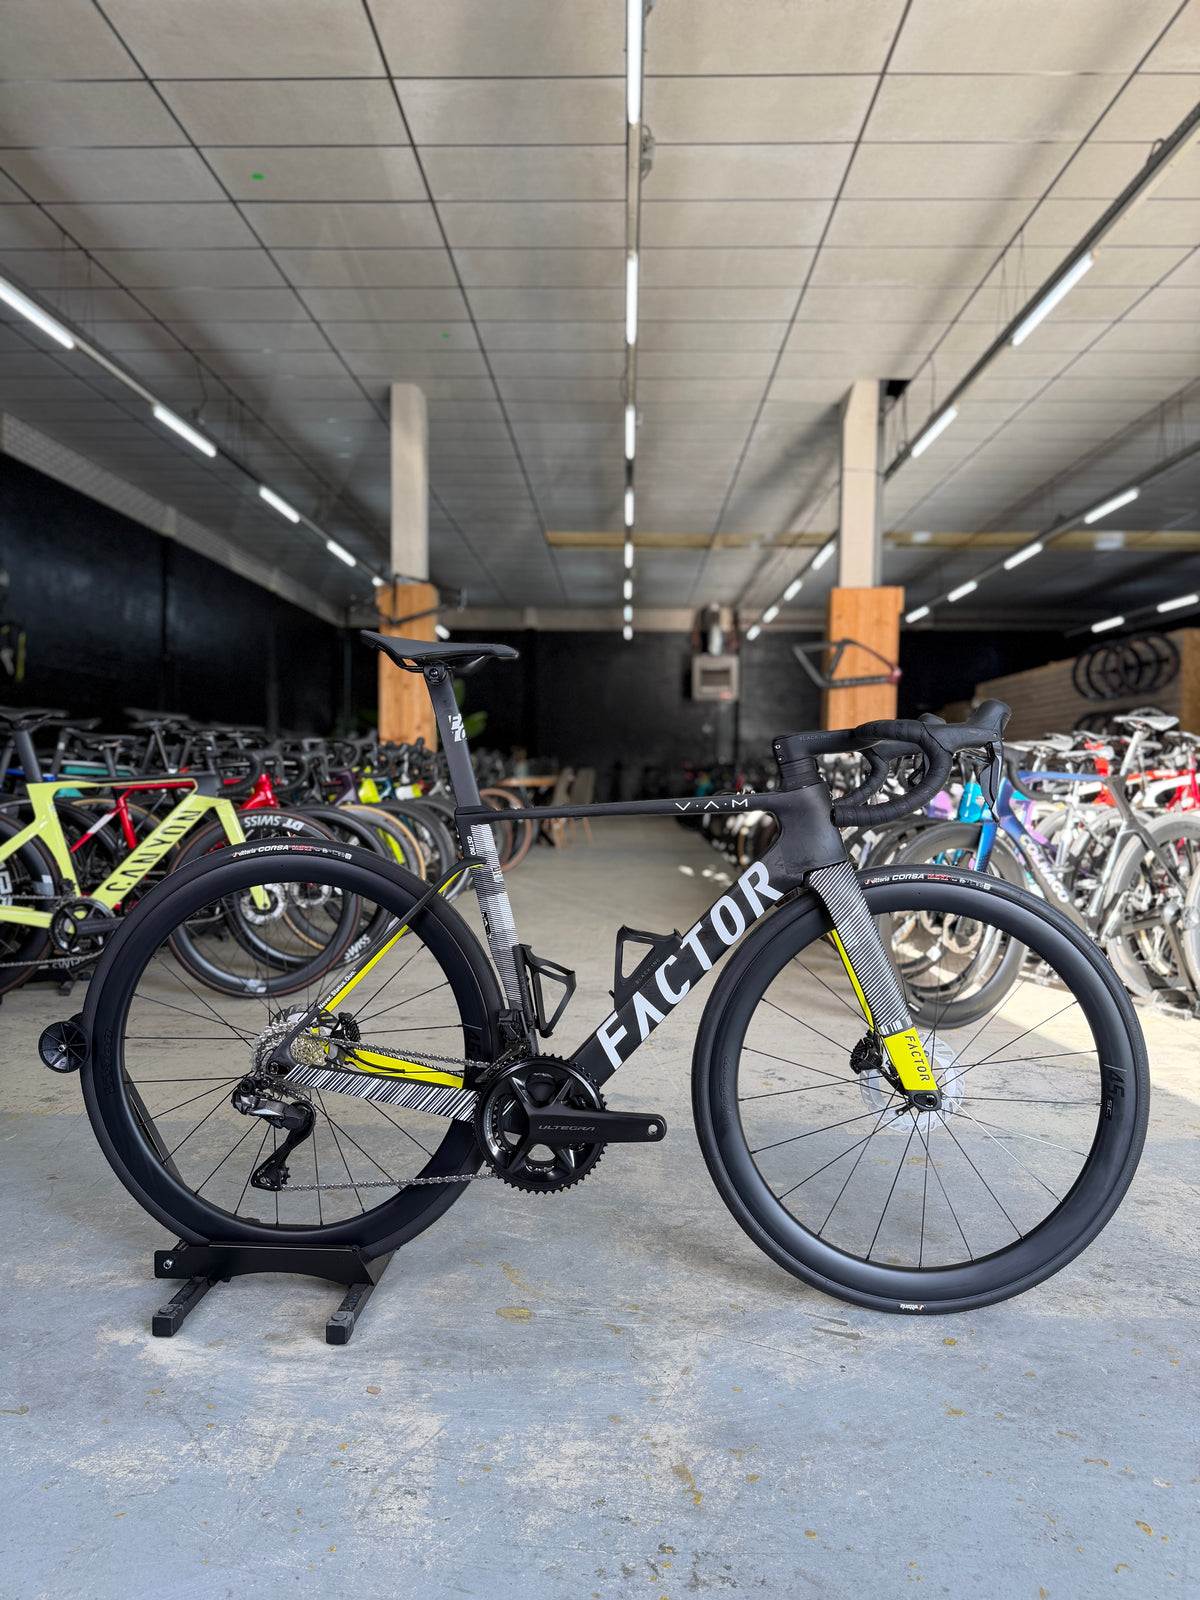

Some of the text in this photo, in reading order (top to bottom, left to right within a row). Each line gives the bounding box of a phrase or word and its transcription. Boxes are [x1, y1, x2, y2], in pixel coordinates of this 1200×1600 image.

[244, 815, 304, 832] DT SWISS
[105, 810, 202, 892] CANYON
[258, 844, 289, 853] CORSA
[466, 835, 476, 856] OSTRO
[892, 873, 924, 881] CORSA
[596, 860, 784, 1070] FACTOR
[904, 1035, 931, 1082] FACTOR
[538, 1124, 596, 1132] ULTEGRA
